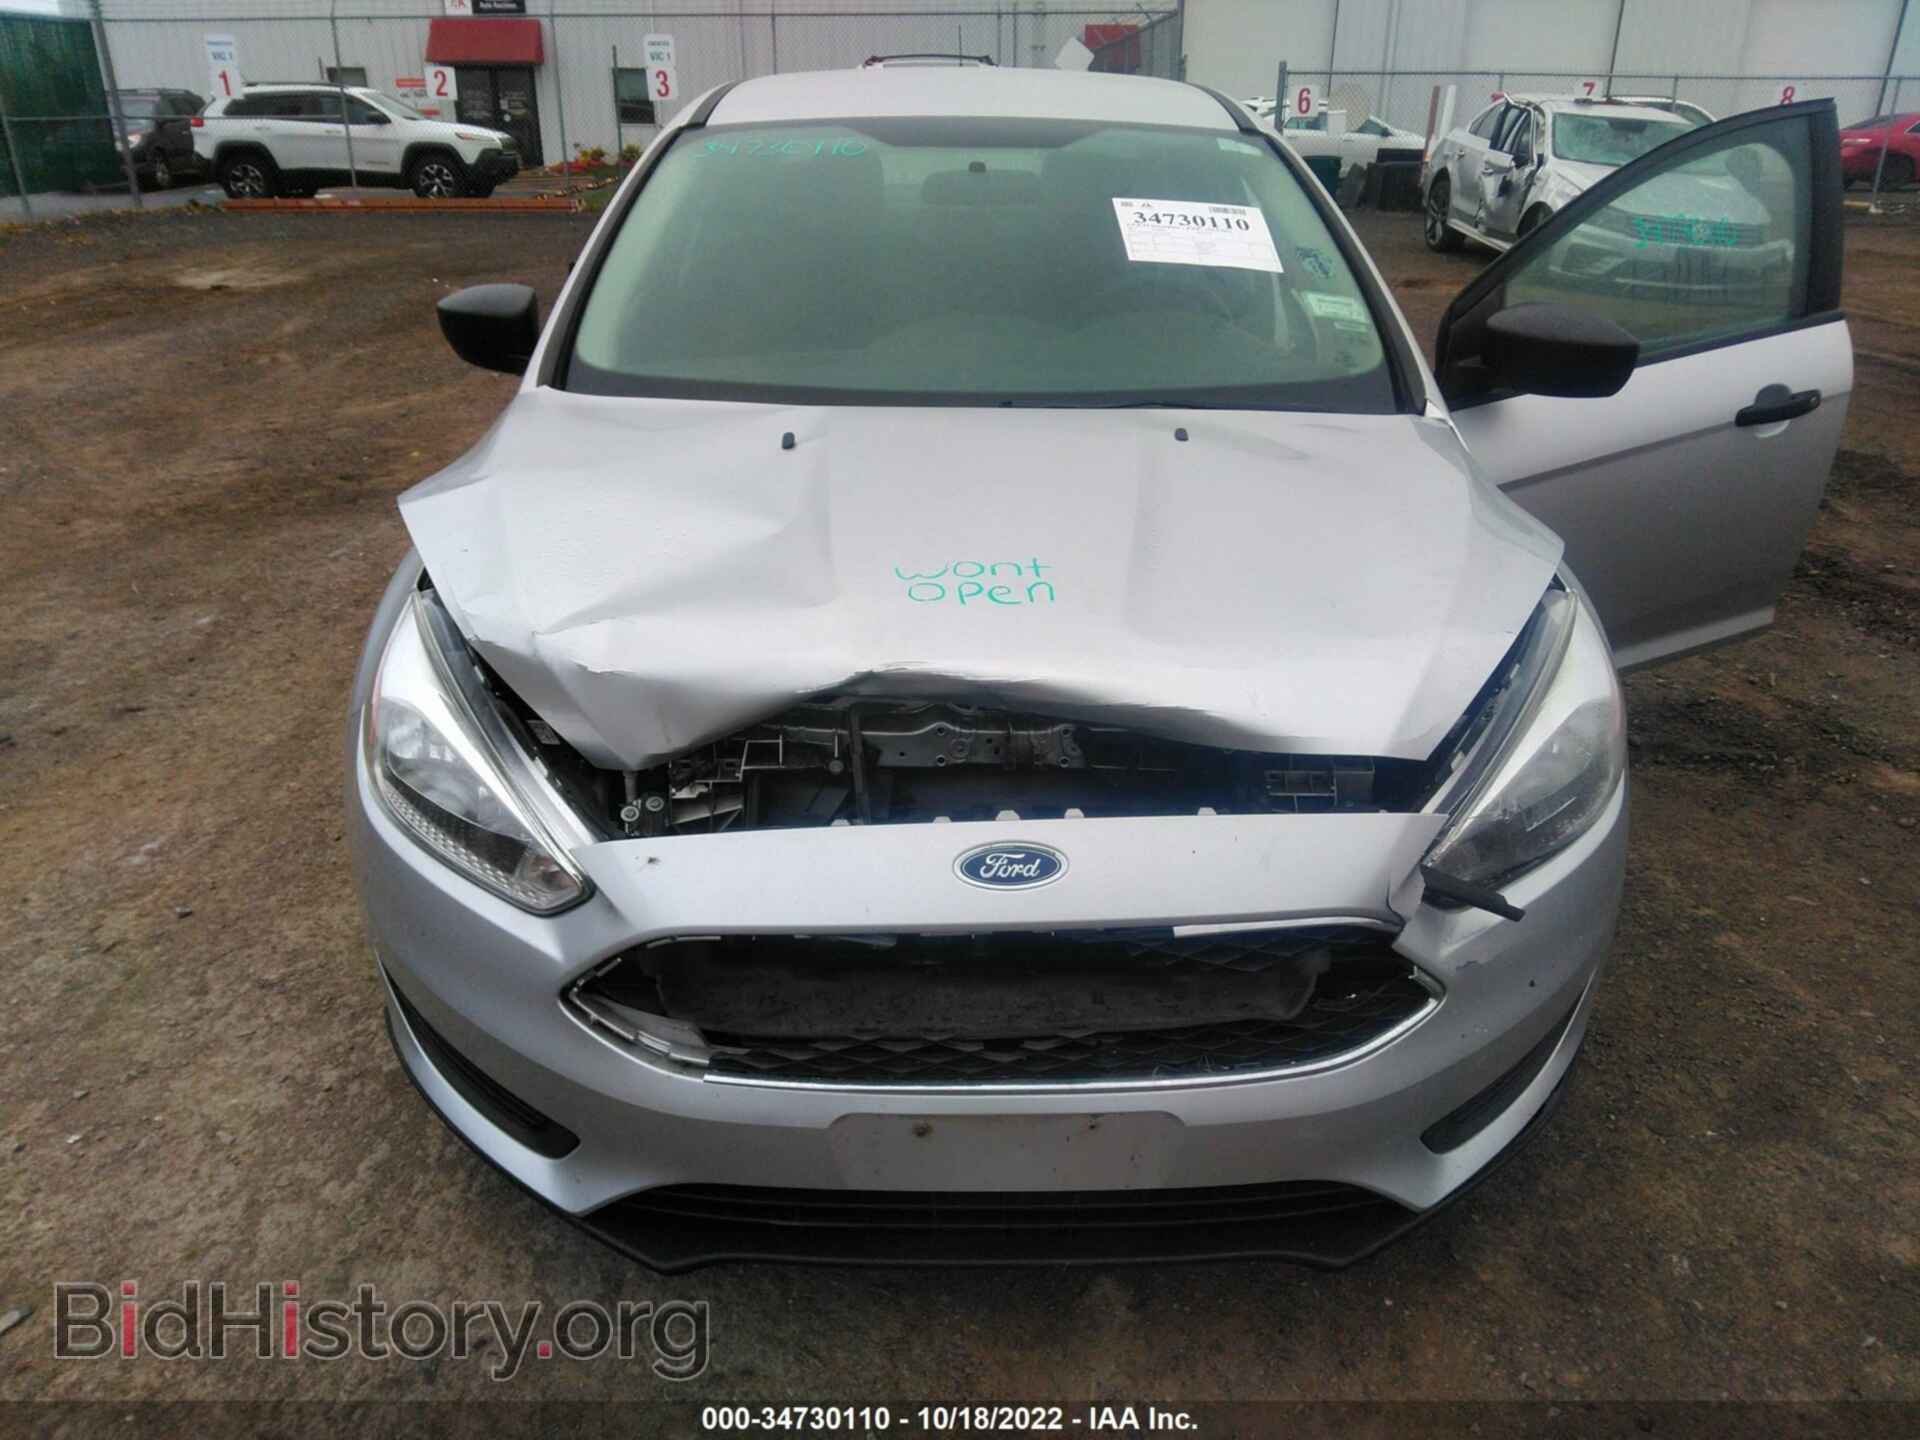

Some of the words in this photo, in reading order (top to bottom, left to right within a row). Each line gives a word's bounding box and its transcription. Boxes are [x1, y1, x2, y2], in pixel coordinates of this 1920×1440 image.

[218, 70, 231, 97] 1
[434, 70, 448, 97] 2
[655, 70, 670, 97] 3
[1780, 86, 1795, 105] 8
[1298, 87, 1311, 114] 6
[1133, 211, 1250, 231] 34730110
[895, 557, 1054, 580] wont
[979, 852, 1041, 879] Ford
